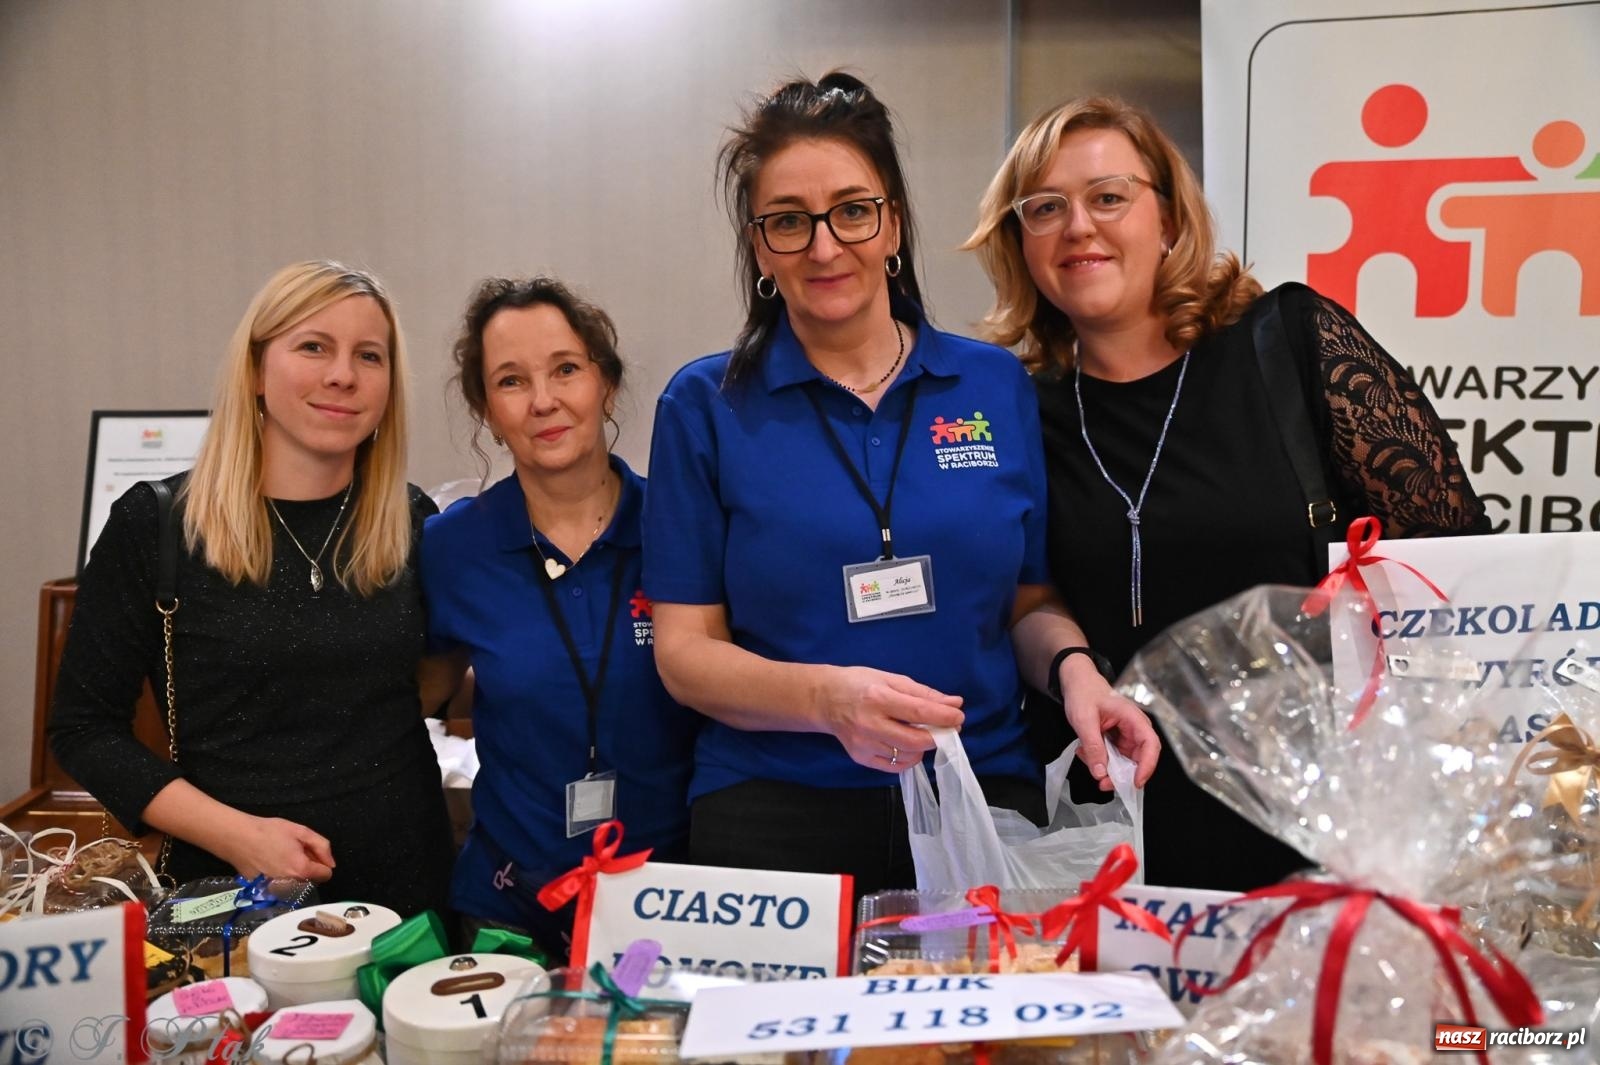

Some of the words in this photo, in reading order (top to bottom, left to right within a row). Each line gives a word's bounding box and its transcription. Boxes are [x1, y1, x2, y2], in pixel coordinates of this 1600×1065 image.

[935, 445, 994, 454] STOWARZYSZENIE
[937, 452, 996, 463] SPEKTRUM
[1440, 419, 1600, 477] KT
[951, 460, 999, 469] RACIBORZU
[1477, 493, 1600, 534] CIB
[635, 638, 645, 646] W
[634, 888, 810, 929] CIASTO
[269, 935, 319, 956] 2
[861, 977, 993, 995] BLIK
[460, 994, 488, 1019] 1
[747, 1013, 850, 1040] 531
[884, 1006, 989, 1031] 118
[1015, 1002, 1124, 1023] 092
